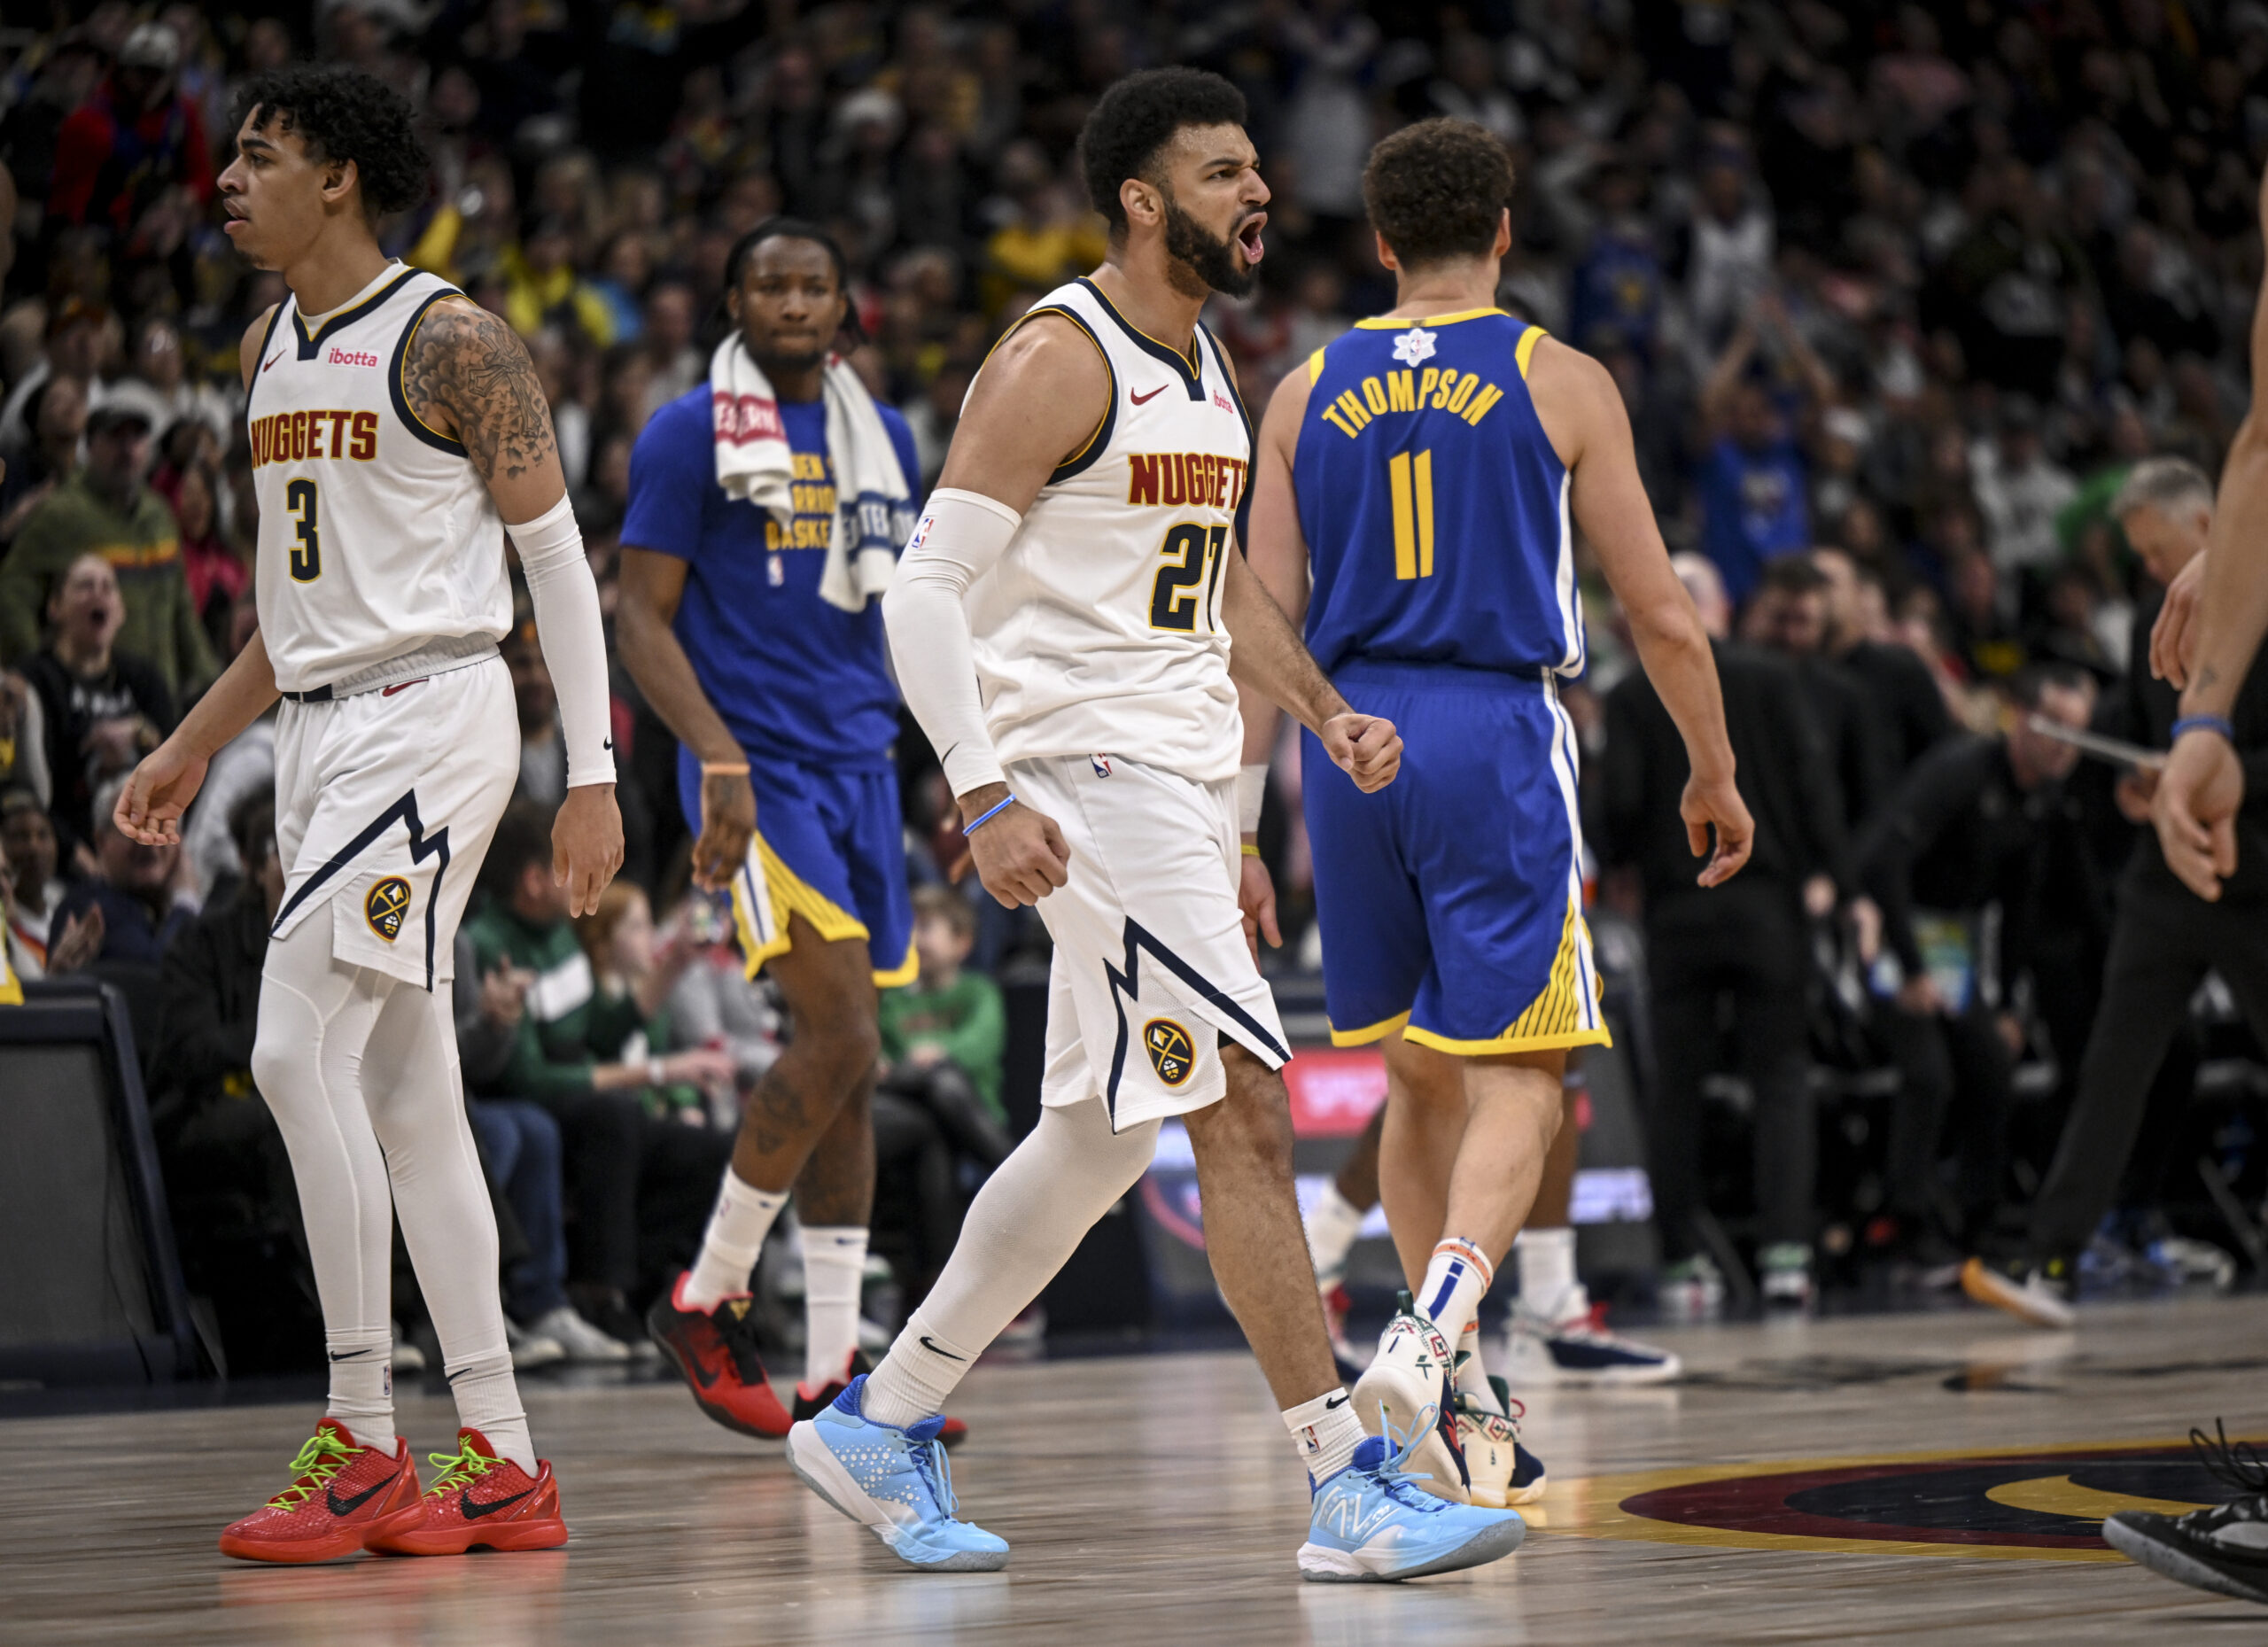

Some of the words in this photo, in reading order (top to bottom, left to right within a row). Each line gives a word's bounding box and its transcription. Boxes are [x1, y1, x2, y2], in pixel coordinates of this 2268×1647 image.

[328, 347, 378, 367] ibotta
[1321, 367, 1504, 439] THOMPSON
[250, 409, 379, 470] NUGGETS
[285, 477, 322, 584] 3
[1389, 448, 1434, 580] 11
